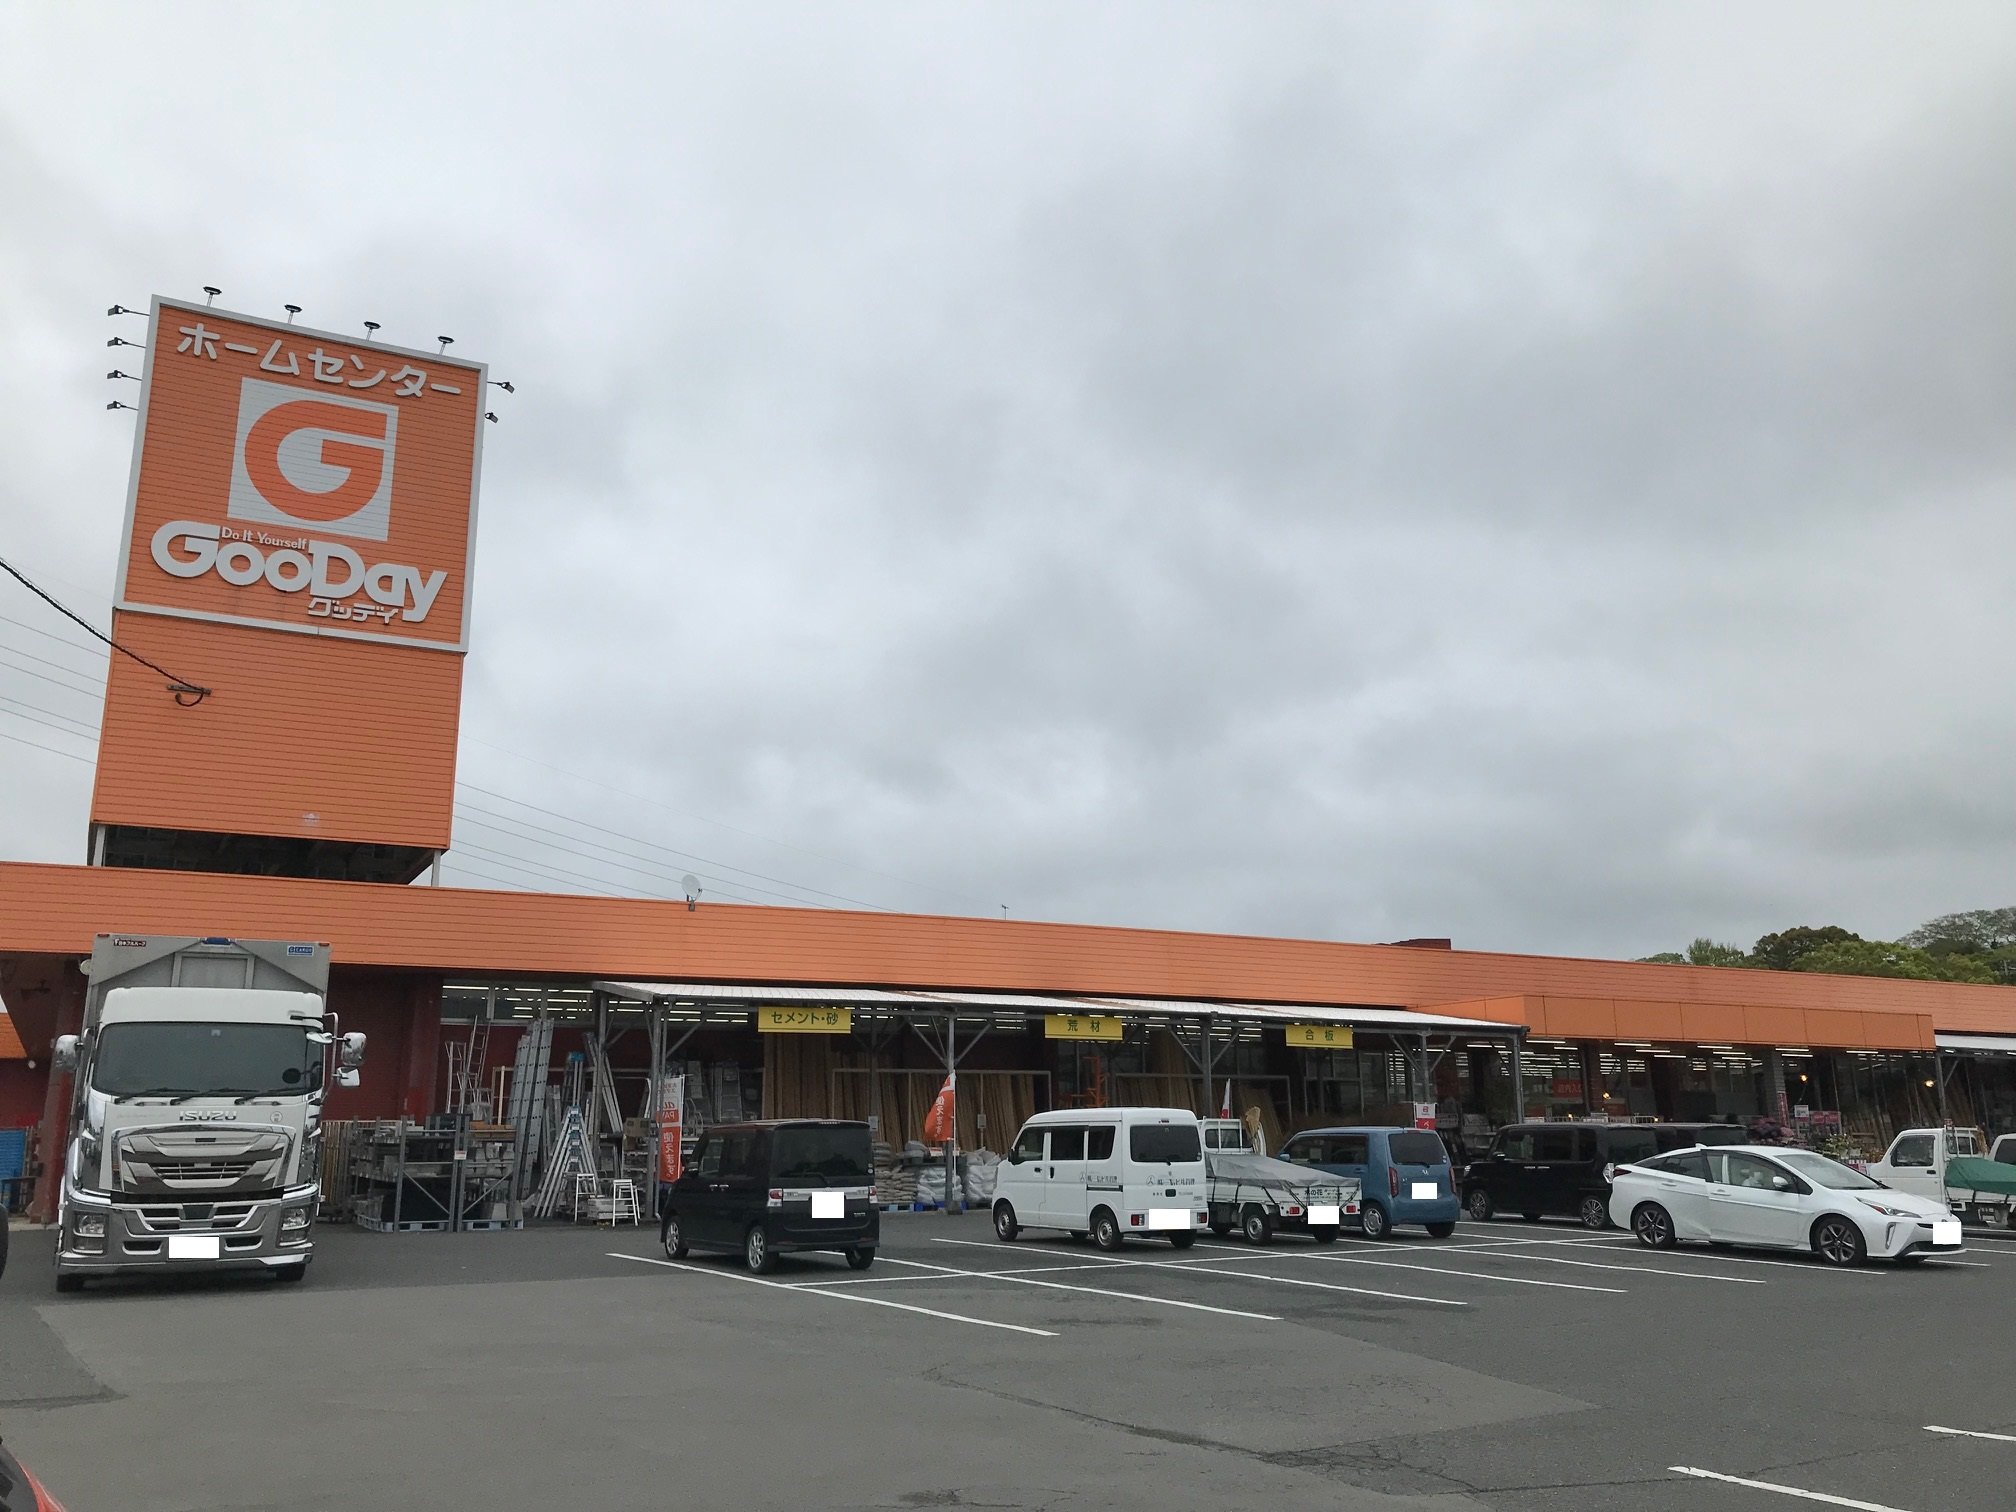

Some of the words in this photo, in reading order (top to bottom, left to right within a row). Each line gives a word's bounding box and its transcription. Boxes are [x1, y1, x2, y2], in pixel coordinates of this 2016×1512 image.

[177, 323, 461, 397] ホームセンター
[245, 399, 388, 522] G
[221, 526, 240, 540] Do
[242, 529, 254, 542] It
[257, 531, 308, 550] Yourself
[771, 1011, 838, 1025] セメント・砂
[1305, 1028, 1333, 1041] 合板
[179, 1110, 237, 1121] ISUZU
